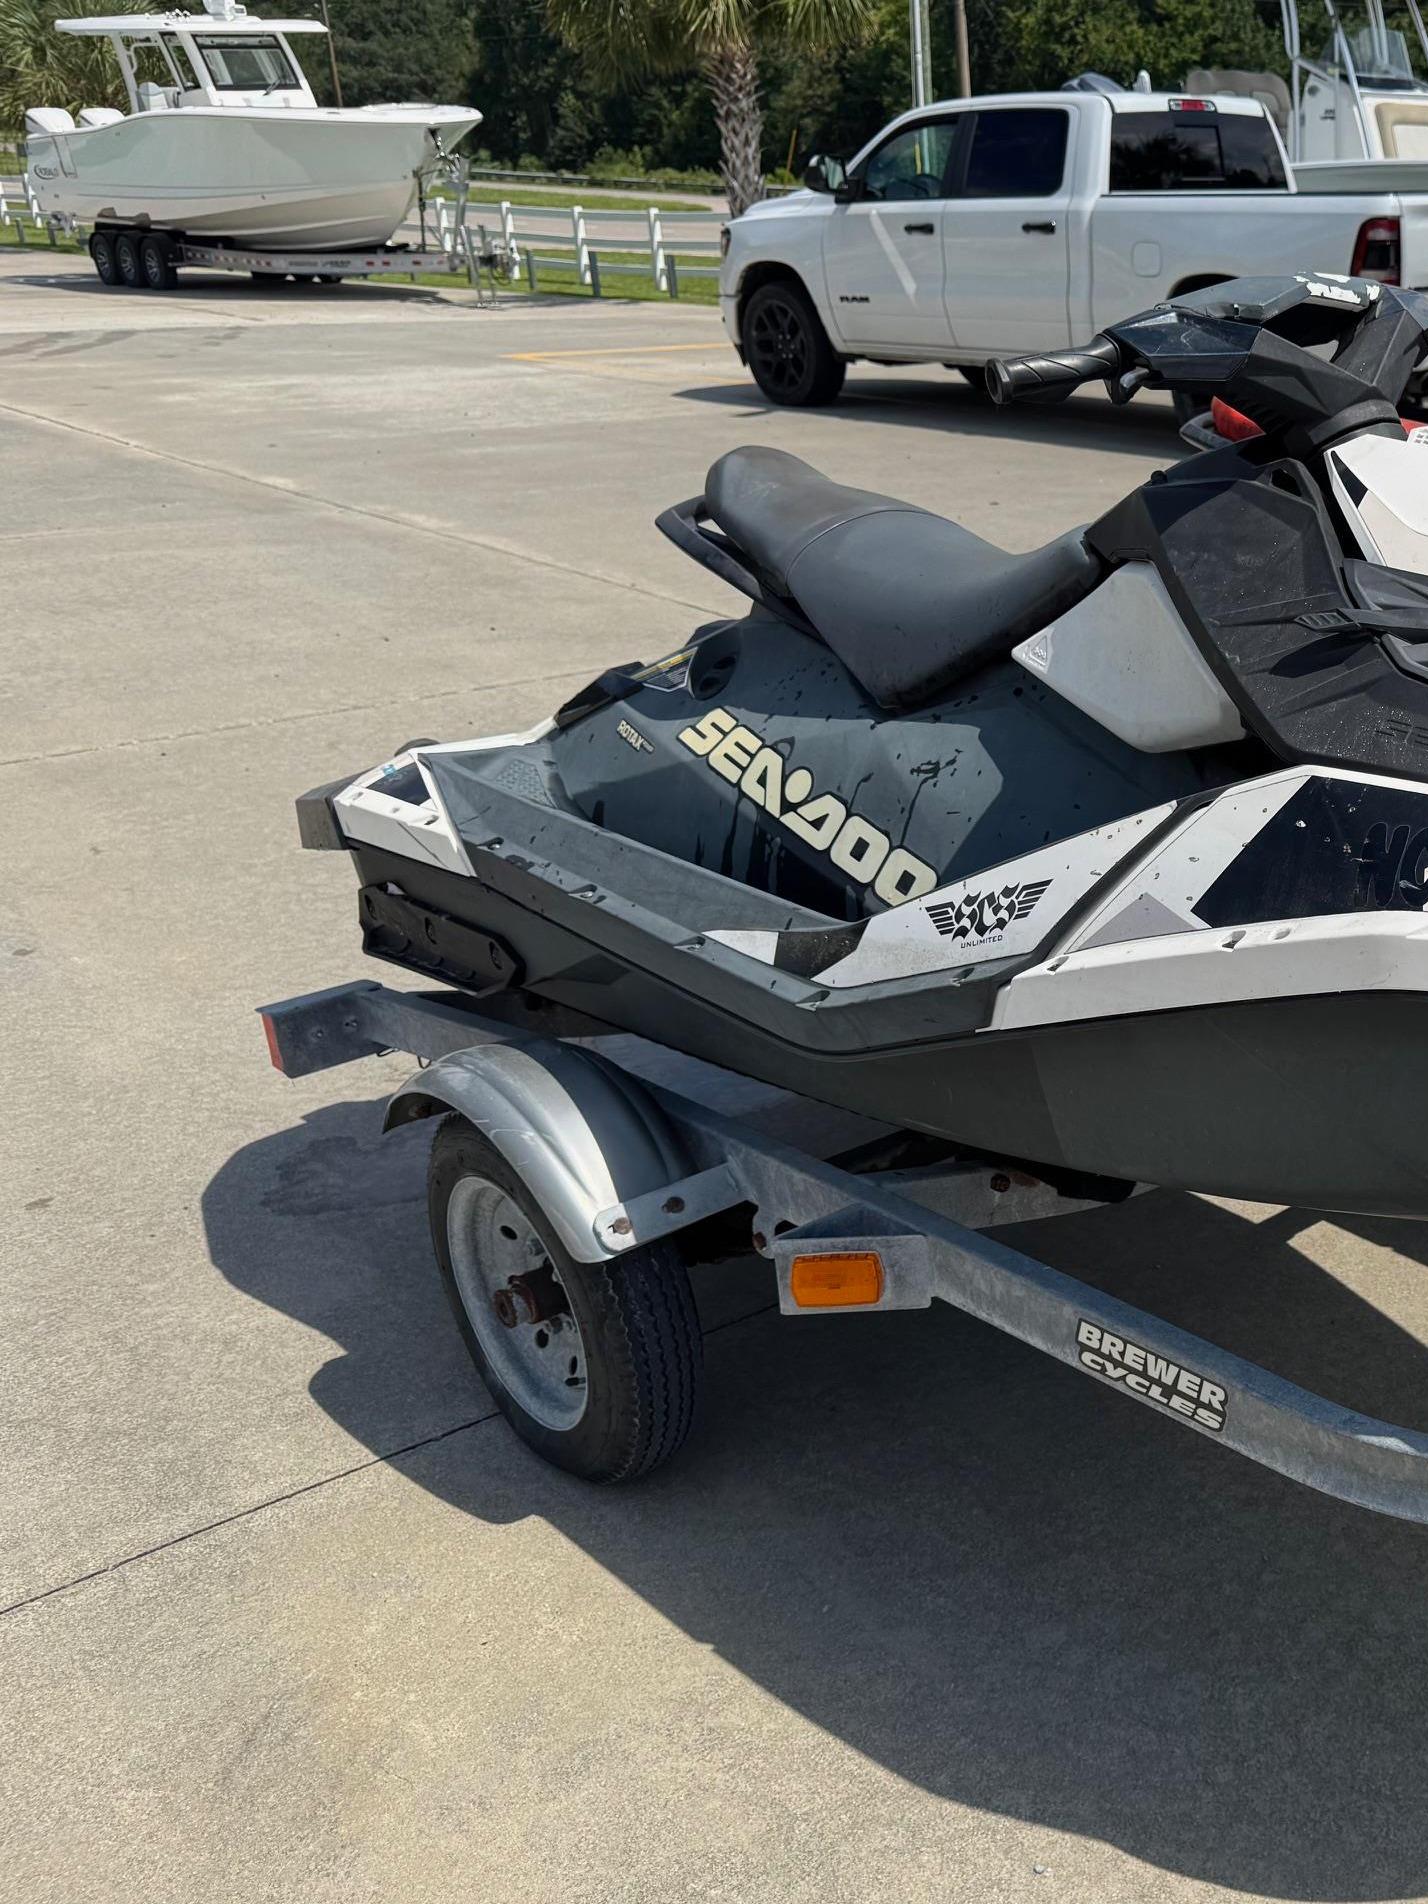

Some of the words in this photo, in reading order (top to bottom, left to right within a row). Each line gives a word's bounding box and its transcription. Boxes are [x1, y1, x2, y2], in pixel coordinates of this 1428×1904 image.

[960, 934, 1003, 949] UNLIMITED
[1077, 1320, 1226, 1412] BREWER
[1080, 1350, 1223, 1430] CYCLES
